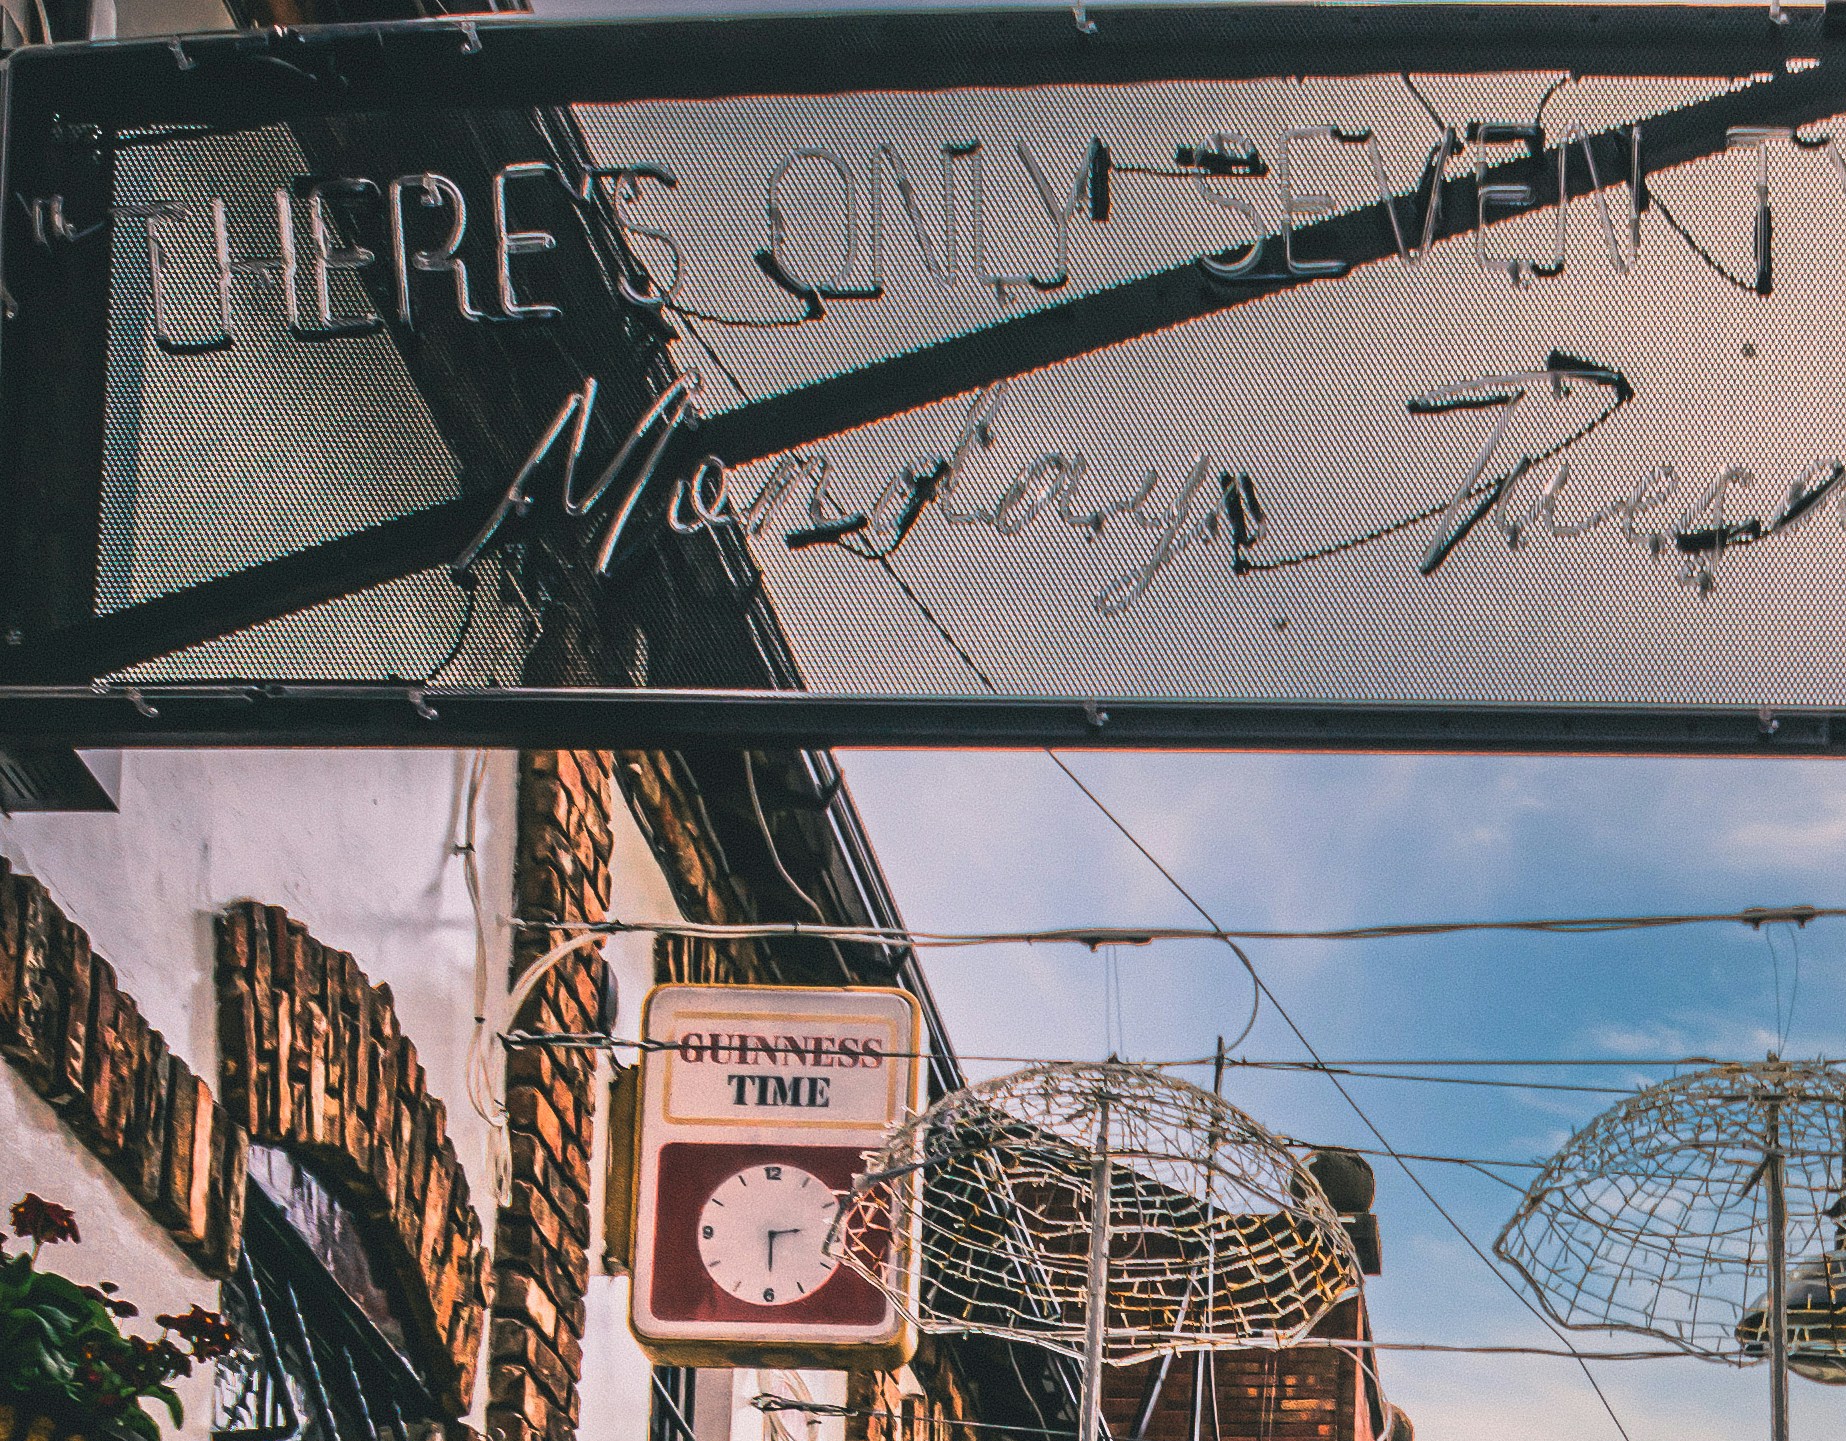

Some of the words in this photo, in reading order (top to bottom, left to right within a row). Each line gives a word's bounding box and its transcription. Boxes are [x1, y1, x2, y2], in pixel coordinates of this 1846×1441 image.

[766, 138, 1108, 298] ONLY
[1196, 122, 1642, 285] SEVEN
[679, 1033, 884, 1068] GUINNESS
[728, 1075, 831, 1108] TIME
[764, 1166, 782, 1181] 12
[702, 1225, 714, 1240] 9
[763, 1287, 776, 1302] 6
